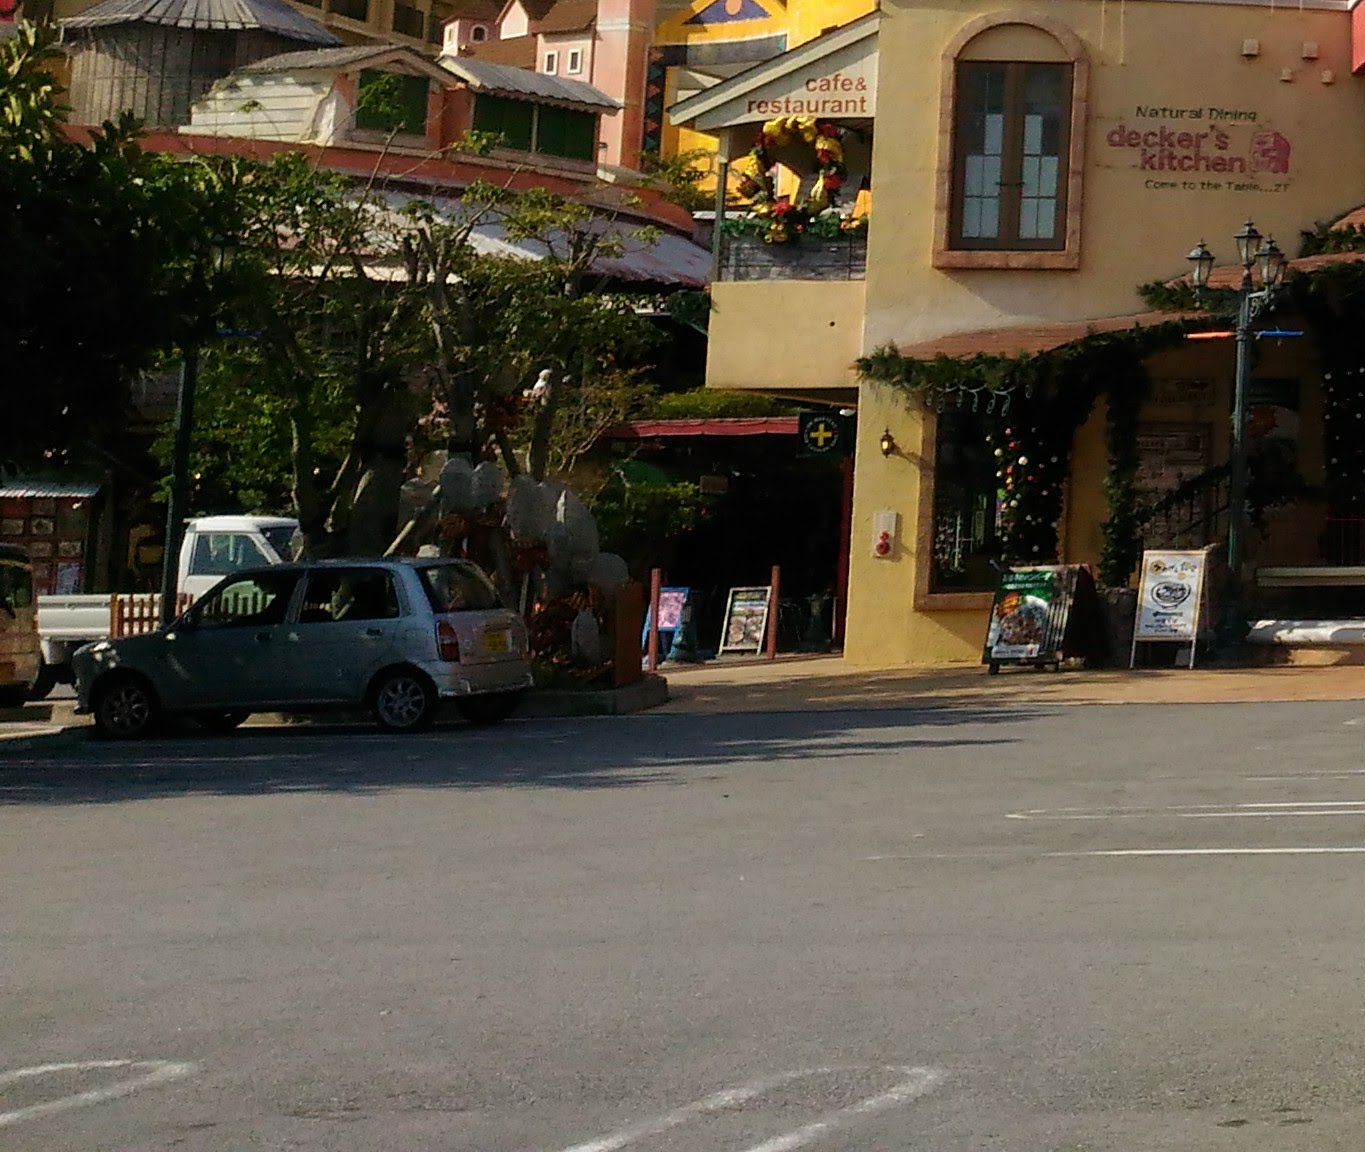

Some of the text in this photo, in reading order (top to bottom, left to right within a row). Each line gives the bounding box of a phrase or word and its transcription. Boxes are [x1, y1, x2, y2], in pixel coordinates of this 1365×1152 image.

[747, 96, 867, 114] restaurant
[1135, 105, 1258, 122] Natural Dining
[1106, 124, 1230, 150] decker's
[1139, 148, 1247, 173] kitchen
